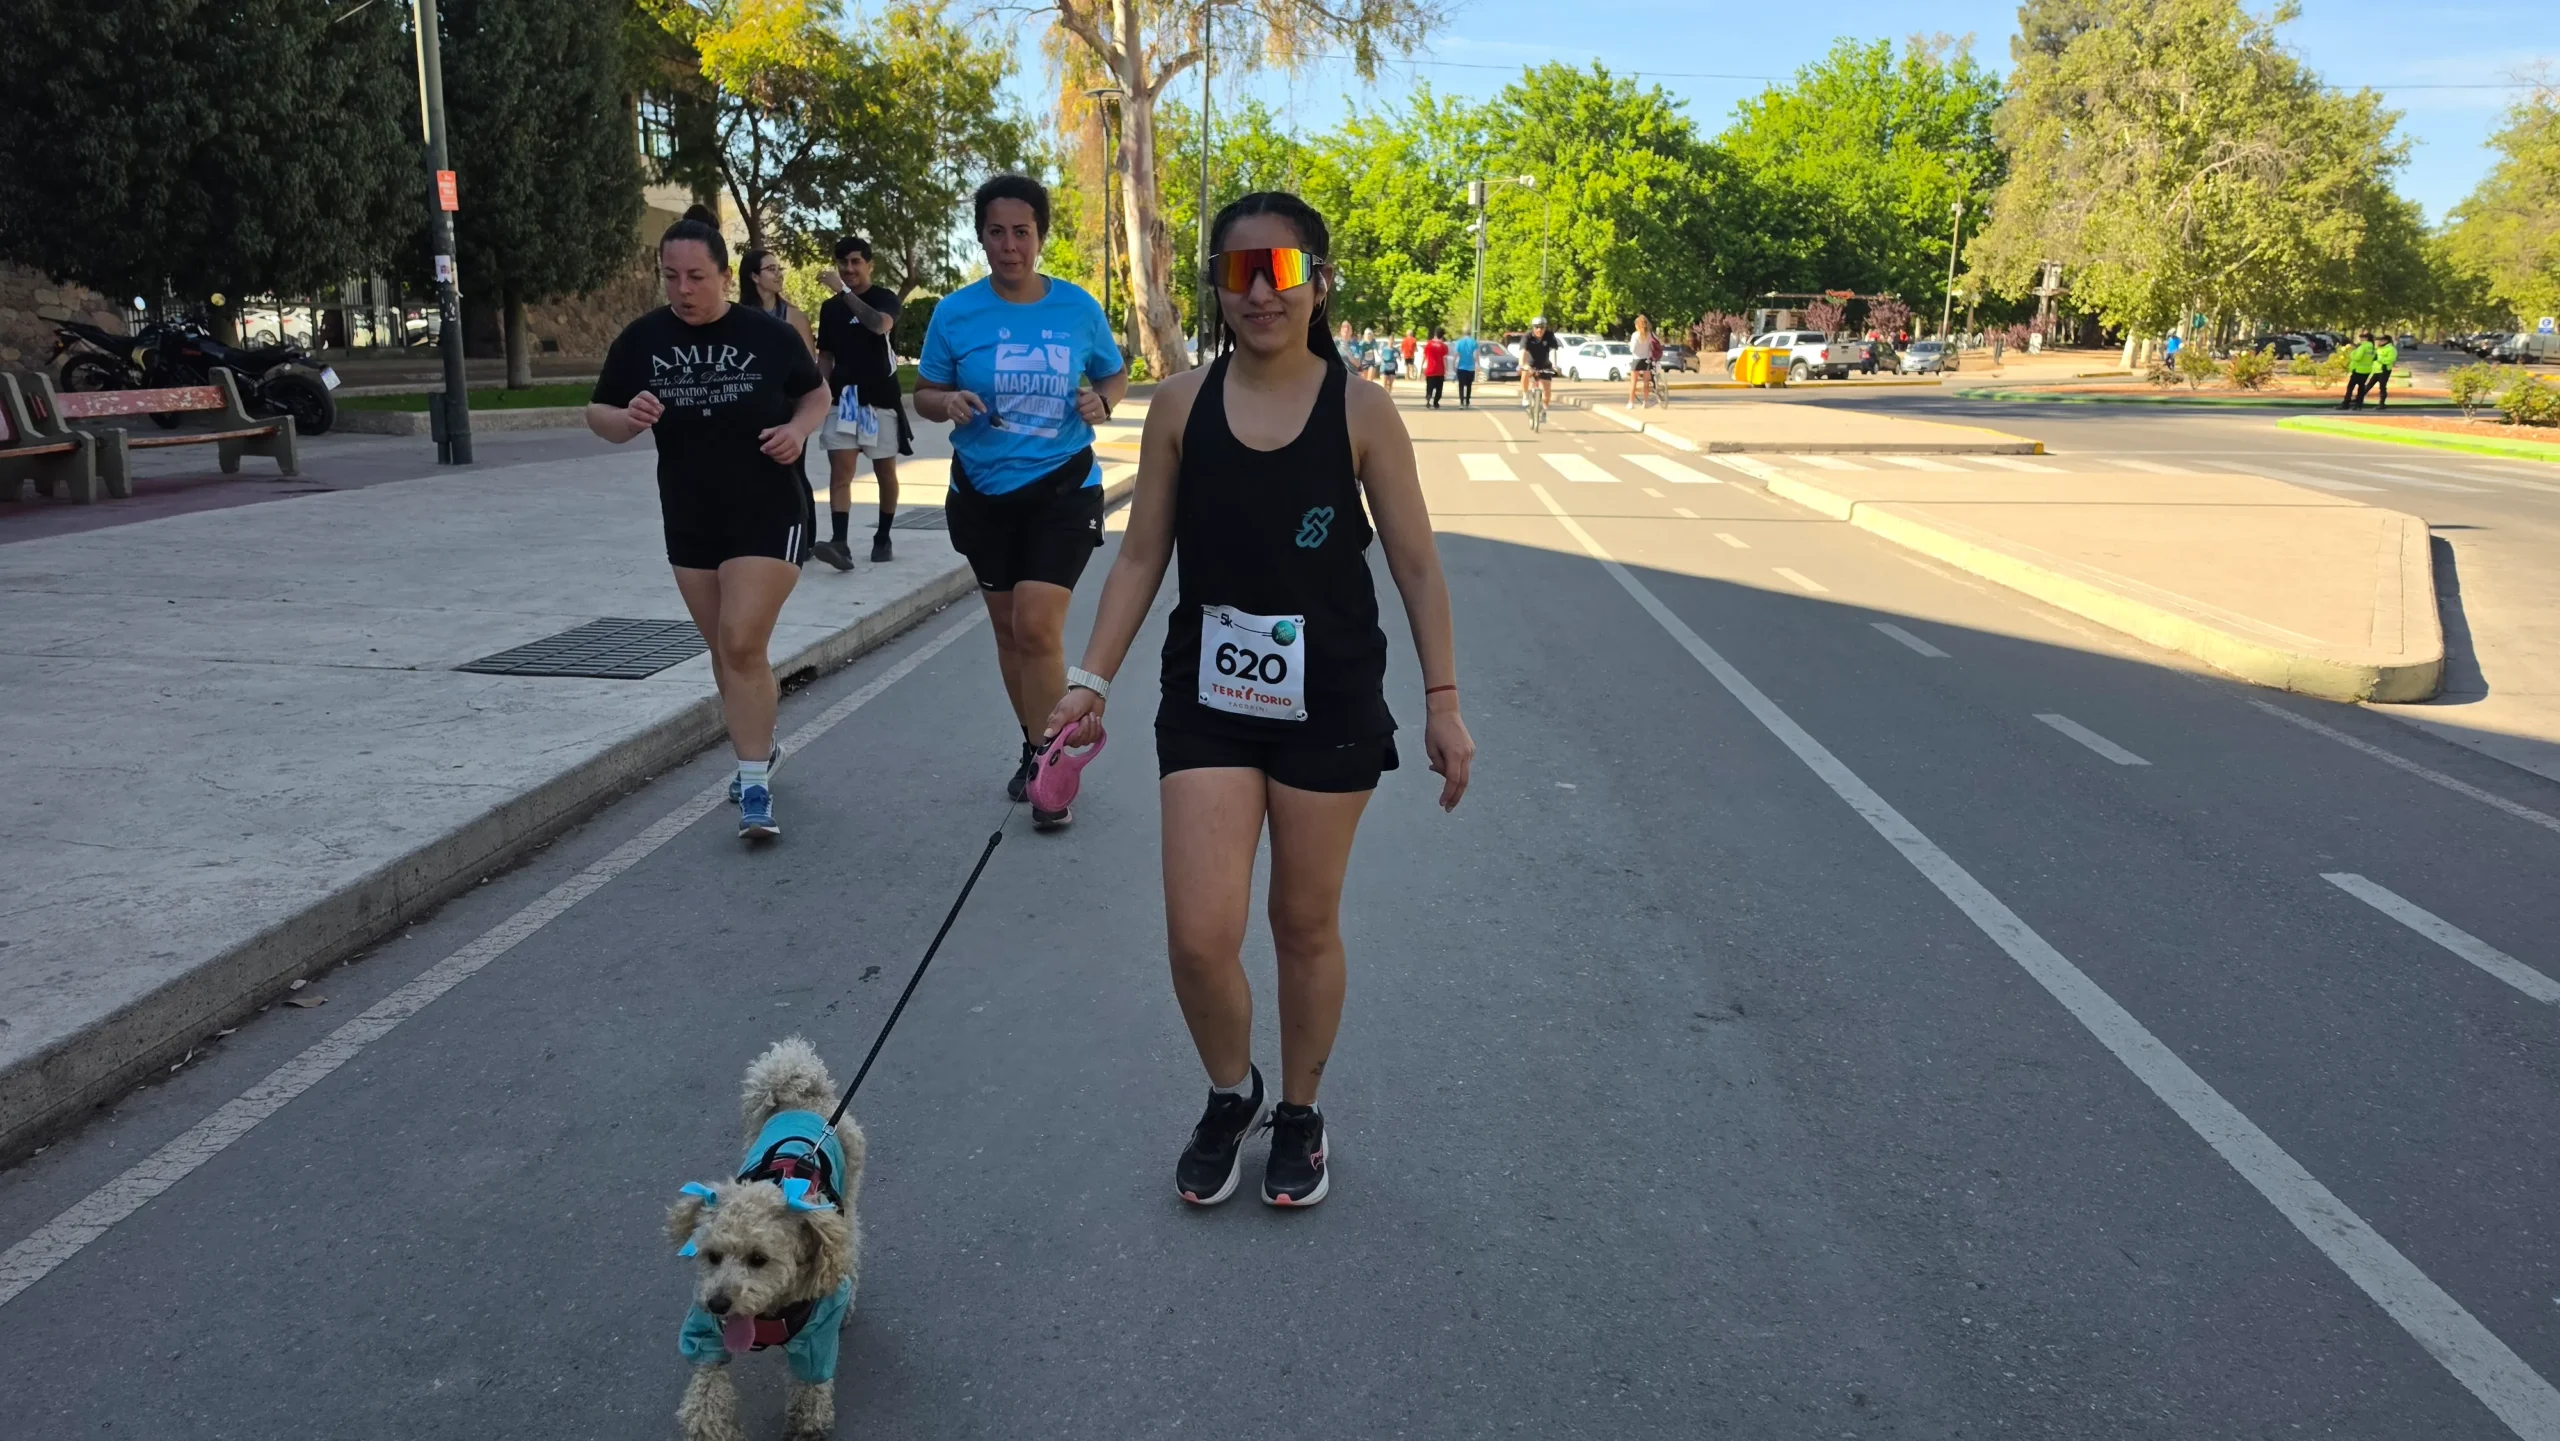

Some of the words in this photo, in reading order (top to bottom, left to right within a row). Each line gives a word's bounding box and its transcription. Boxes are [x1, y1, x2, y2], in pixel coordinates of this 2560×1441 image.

[652, 344, 757, 377] AMIRI
[673, 373, 695, 385] Arts
[699, 370, 742, 384] District
[659, 386, 709, 398] IMAGINATION
[723, 382, 754, 393] DREAMS
[675, 396, 695, 407] ARTS
[708, 392, 738, 404] CRAFTS
[1215, 642, 1288, 685] 620
[1211, 683, 1292, 707] TERRITORIO
[1228, 701, 1269, 713] YACOPINI
